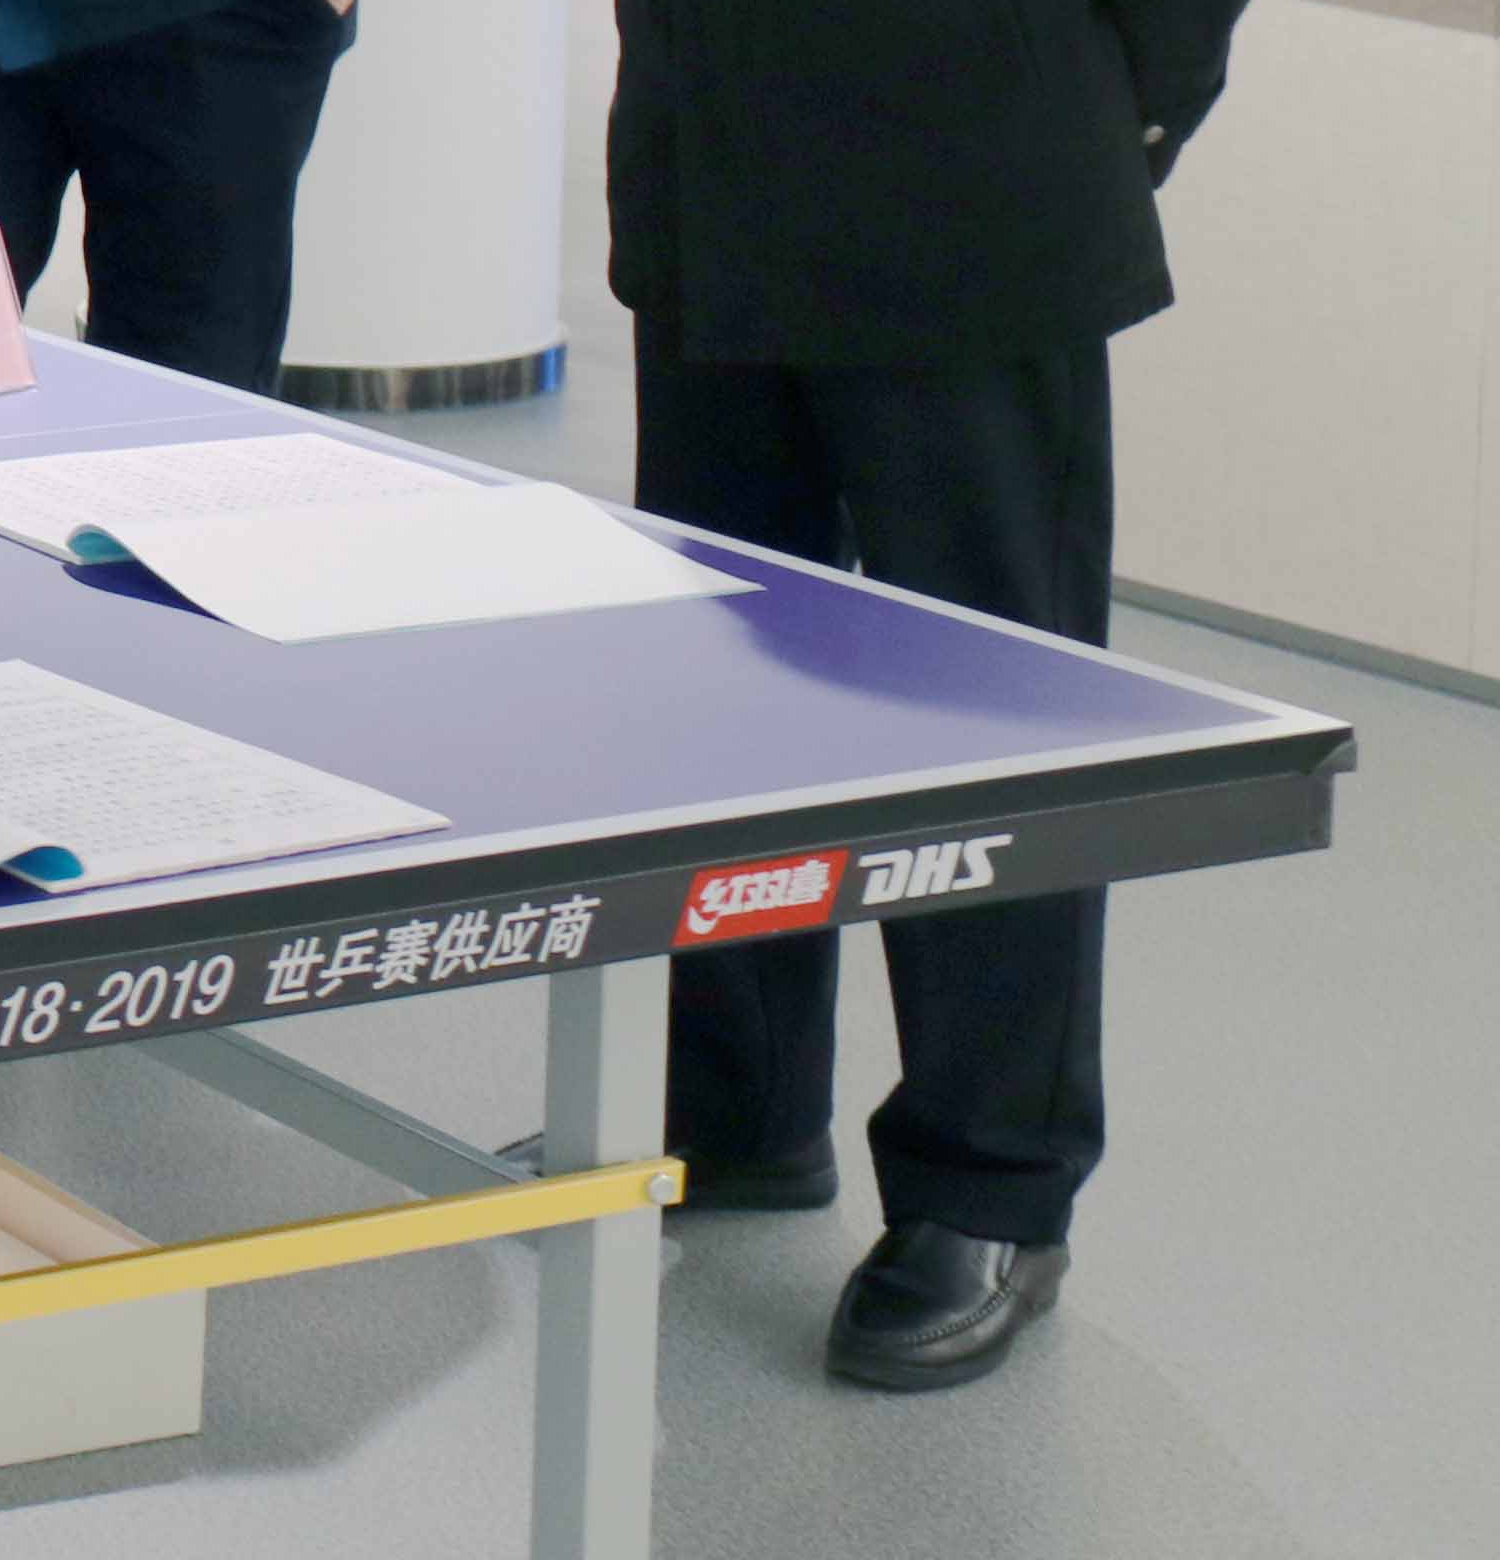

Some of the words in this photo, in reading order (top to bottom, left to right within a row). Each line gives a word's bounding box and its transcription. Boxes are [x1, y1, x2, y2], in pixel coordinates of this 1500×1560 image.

[688, 859, 831, 934] 红双喜
[857, 833, 1013, 905] DHS
[263, 893, 602, 1006] 世乒赛供应商
